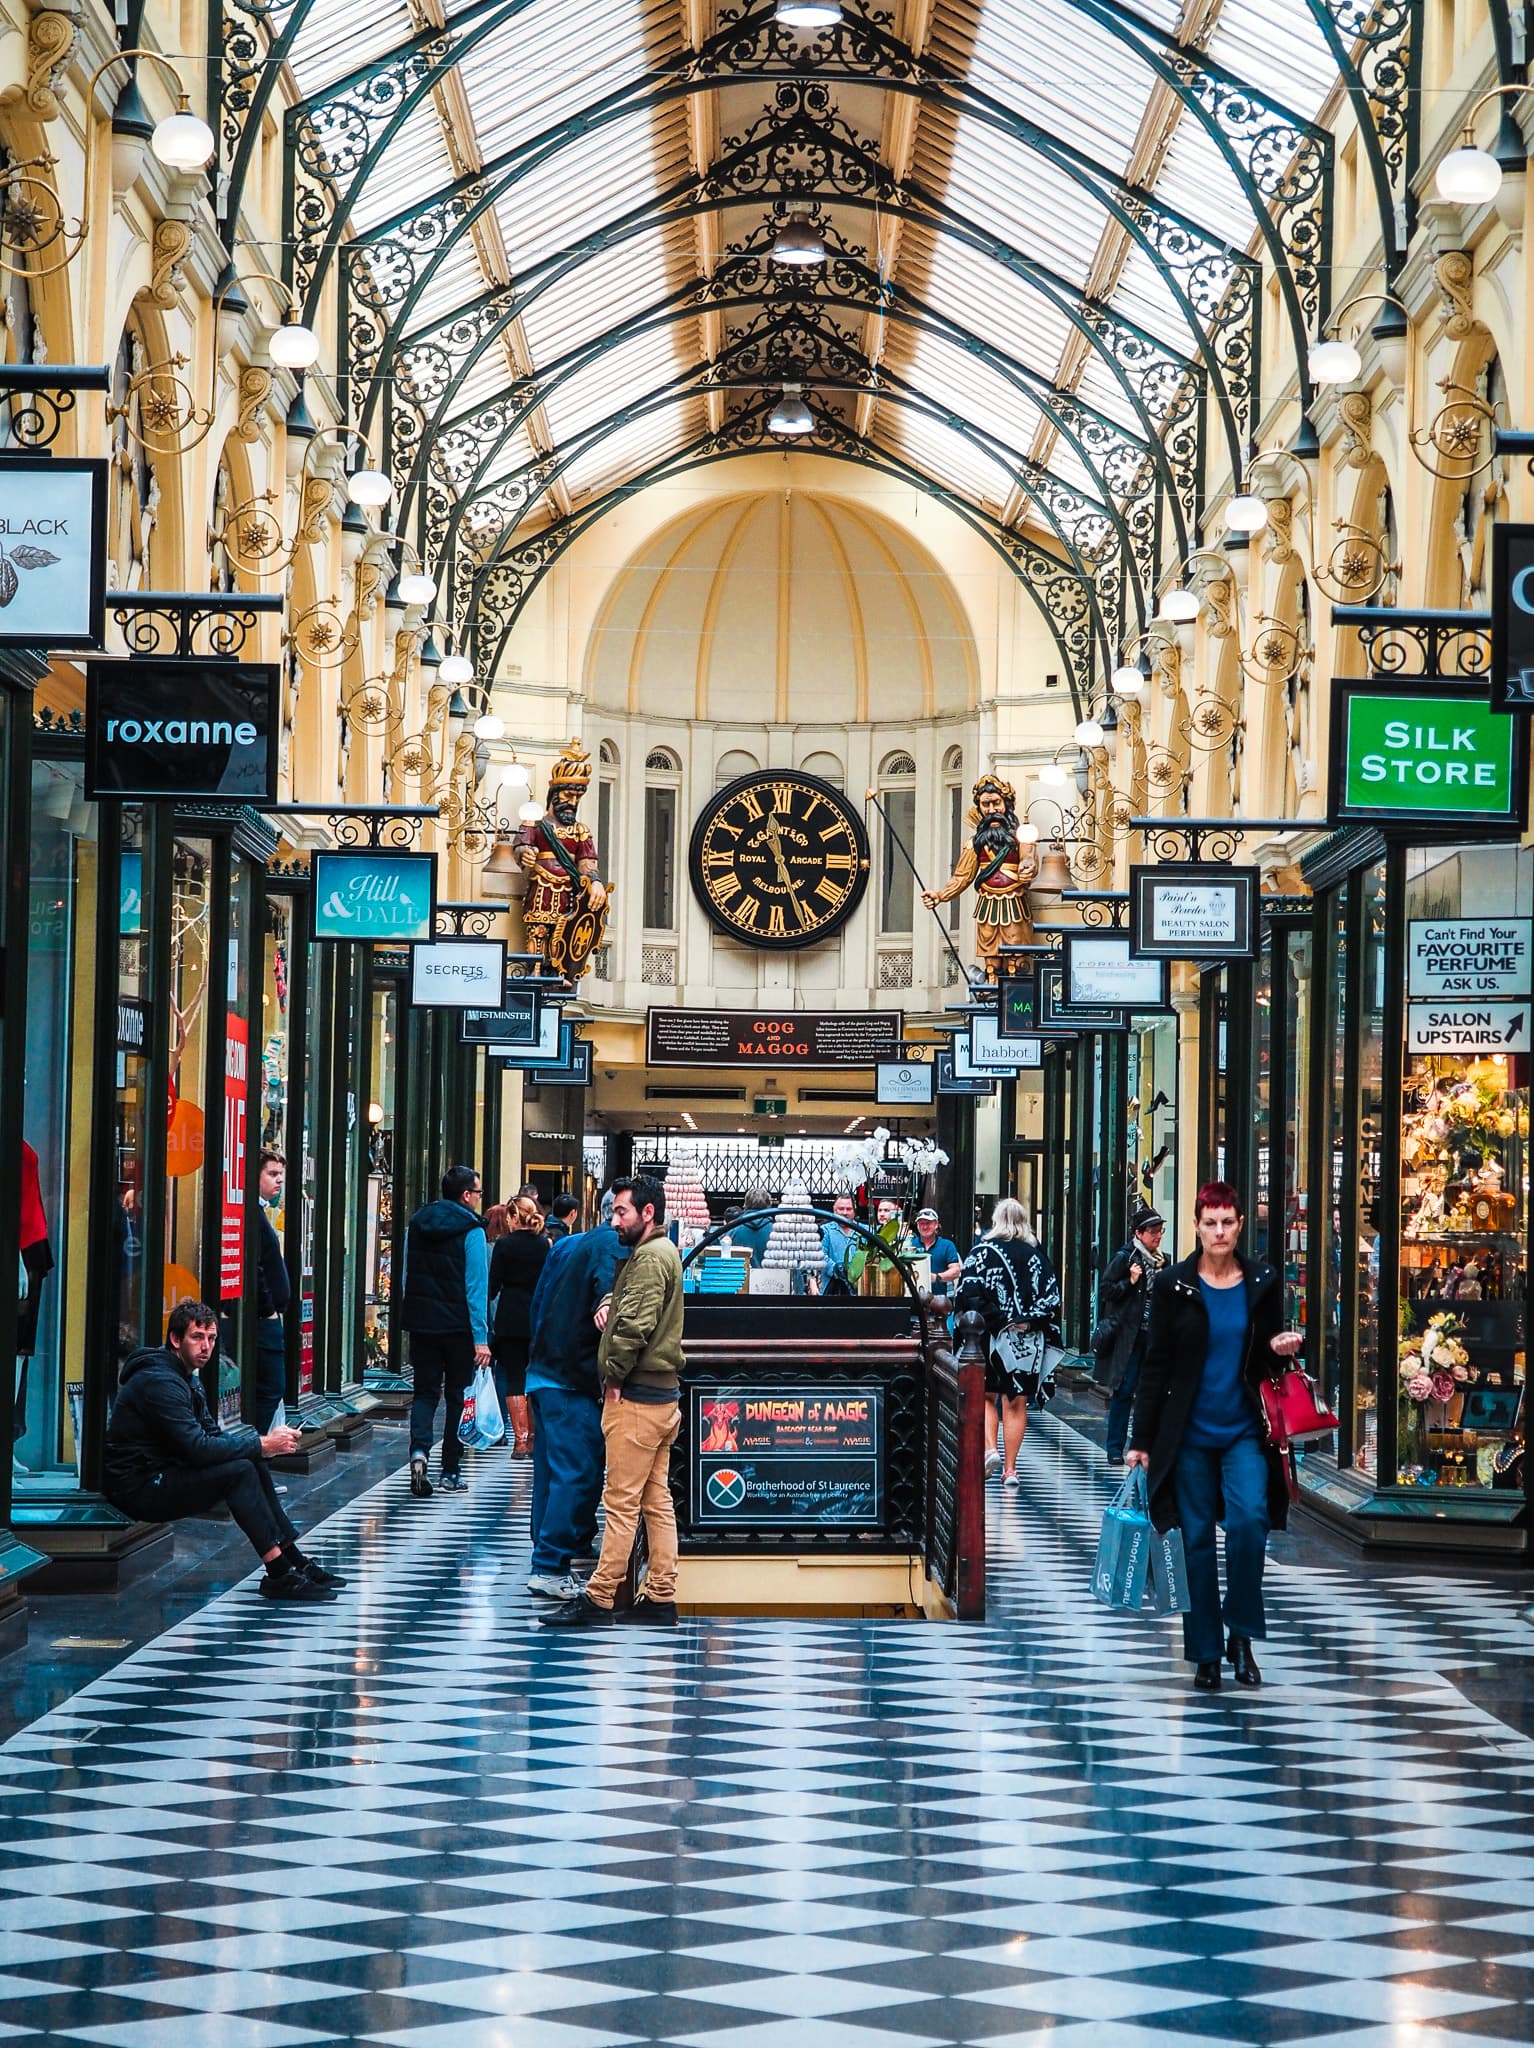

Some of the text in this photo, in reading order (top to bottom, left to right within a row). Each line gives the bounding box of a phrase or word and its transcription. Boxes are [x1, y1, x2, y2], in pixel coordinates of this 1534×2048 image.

[0, 519, 68, 535] BLACK
[106, 719, 257, 745] roxanne
[1383, 721, 1476, 752] SILK
[1360, 754, 1497, 787] STORE
[739, 793, 765, 823] XI
[770, 788, 793, 814] XII
[801, 798, 821, 822] I
[717, 818, 744, 842] X
[818, 822, 845, 842] II
[708, 848, 735, 867] IX
[739, 854, 823, 865] ROYAL ARCADE
[825, 853, 851, 870] III
[348, 873, 400, 902] Hill
[711, 871, 742, 904] VIII
[322, 891, 421, 924] & DALE
[733, 894, 761, 925] VII
[768, 905, 785, 931] VI
[1199, 920, 1230, 928] SALON
[1169, 929, 1224, 937] PERFUMERY
[1425, 927, 1517, 941] Can't Find Your
[1417, 942, 1525, 957] FAVOURITE
[425, 964, 484, 976] SECRETS
[1426, 957, 1517, 972] PERFUME
[1442, 977, 1500, 990] ASK US.
[467, 1010, 531, 1021] WESTMINSTER
[1428, 1012, 1491, 1027] SALON
[753, 1022, 795, 1033] GOG
[1416, 1030, 1502, 1045] UPSTAIRS
[737, 1042, 809, 1055] MAGOG
[981, 1045, 1032, 1059] habbot.
[528, 1131, 576, 1140] CANTURI
[745, 1401, 868, 1422] DUNGEON of MAGIC
[746, 1480, 870, 1491] Brotherhood of St Laurence
[1122, 1531, 1142, 1606] cinori.com.au
[1162, 1539, 1178, 1609] cinori.com.au
